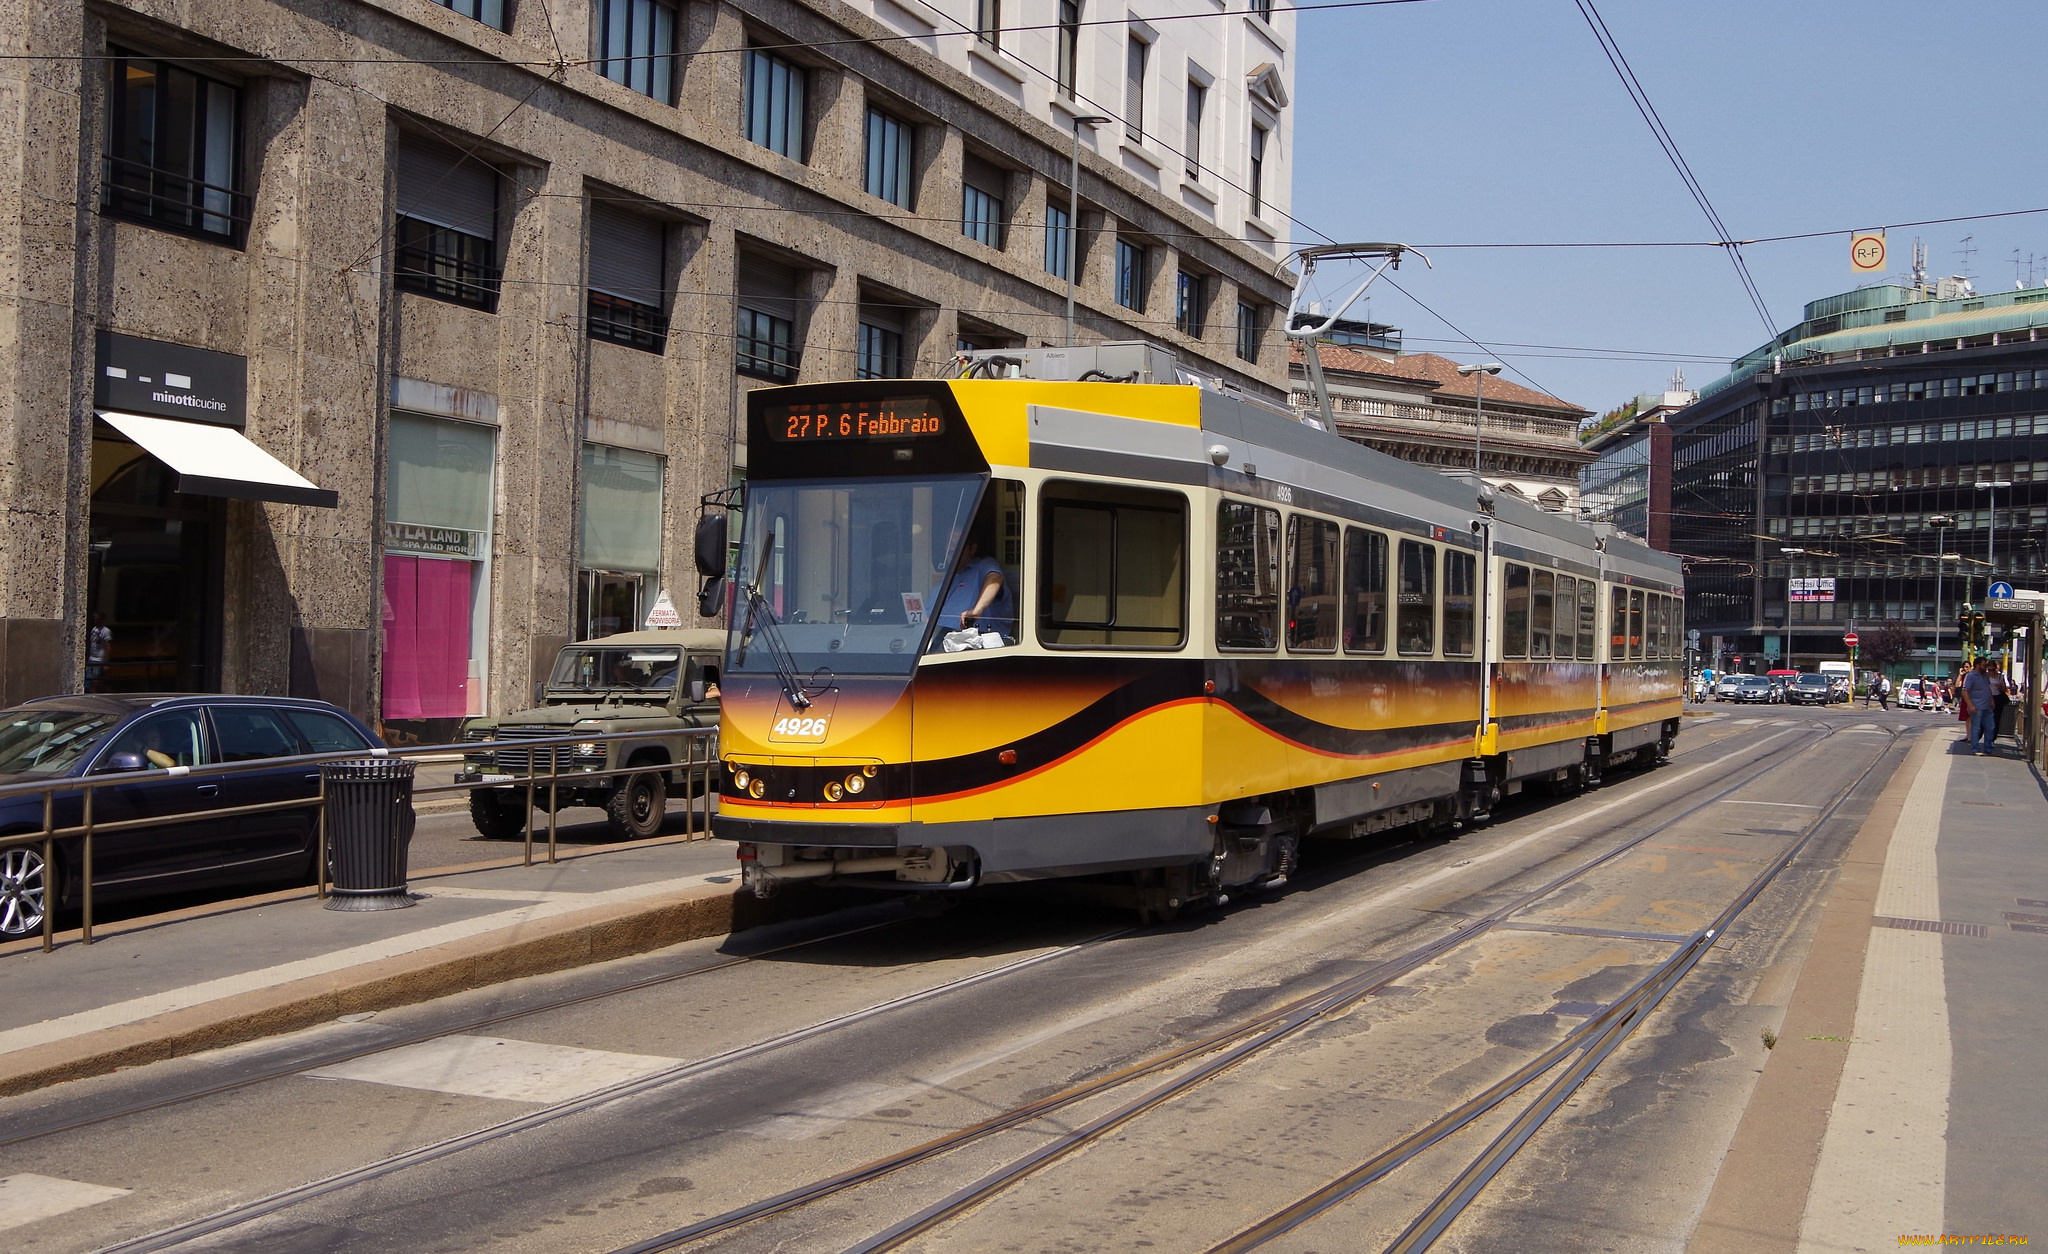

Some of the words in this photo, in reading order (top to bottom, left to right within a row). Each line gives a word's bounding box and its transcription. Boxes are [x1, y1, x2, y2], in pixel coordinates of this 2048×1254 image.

[1857, 247, 1879, 258] R-F
[153, 391, 226, 411] minotticucine
[787, 415, 810, 438] 27
[816, 414, 833, 437] P.
[840, 413, 851, 436] 6
[858, 411, 939, 435] Febbraio
[1277, 485, 1292, 503] 4926
[430, 528, 461, 544] LAND
[402, 541, 421, 549] SPA
[422, 543, 443, 551] AND
[652, 609, 676, 617] FERMATA
[911, 612, 923, 622] 27
[773, 717, 827, 736] 4926
